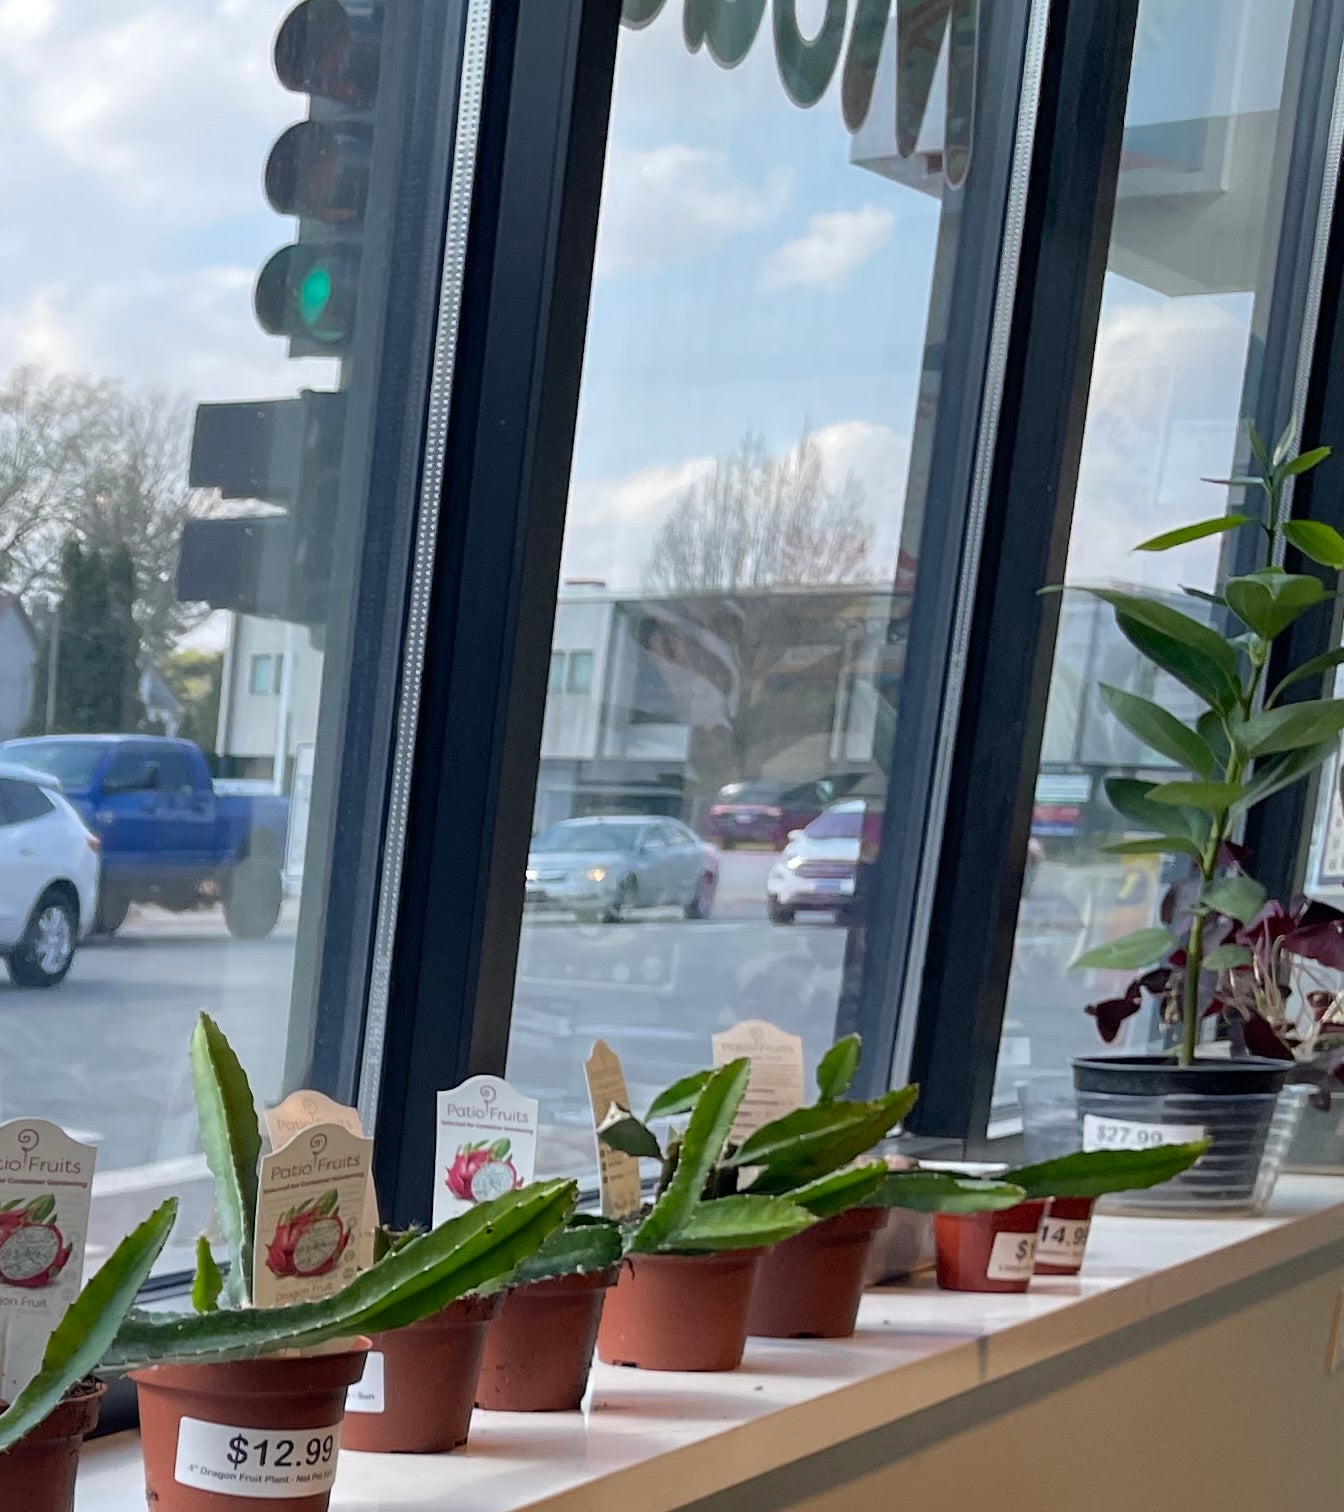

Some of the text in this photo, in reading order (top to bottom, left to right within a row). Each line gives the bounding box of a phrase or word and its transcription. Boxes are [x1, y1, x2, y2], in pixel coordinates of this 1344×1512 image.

[447, 1103, 529, 1123] Patio Fruits
[28, 1156, 81, 1174] Fruits
[271, 1154, 360, 1181] Patio Fruits
[21, 1296, 47, 1308] Fruit
[227, 1433, 334, 1471] $12.99
[200, 1467, 237, 1480] Dragon
[239, 1472, 262, 1483] Fruit
[265, 1475, 289, 1483] Plant
[296, 1474, 310, 1483] Not
